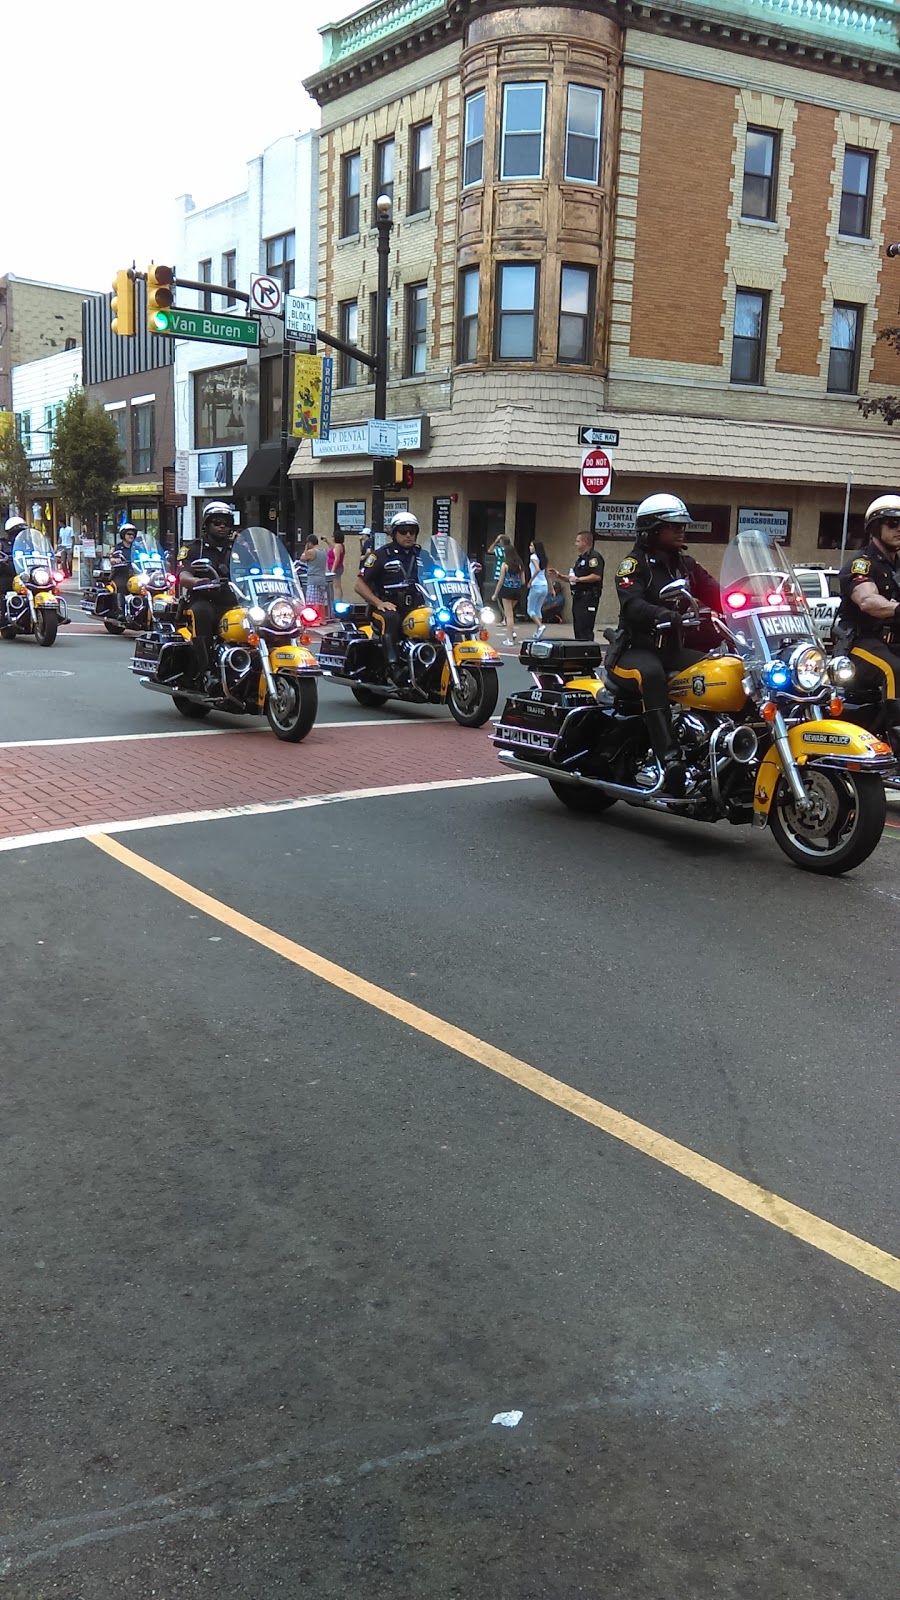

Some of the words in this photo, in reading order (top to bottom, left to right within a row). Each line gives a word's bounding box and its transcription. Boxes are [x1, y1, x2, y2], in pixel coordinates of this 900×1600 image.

[291, 309, 311, 321] BLOCK
[172, 315, 196, 332] Van
[203, 319, 241, 338] Buren
[247, 325, 255, 334] St
[288, 319, 299, 330] THE
[302, 322, 315, 333] BOX
[322, 358, 332, 439] IRONBOUND
[339, 429, 366, 443] DENTAL
[592, 432, 603, 441] ONE
[604, 433, 615, 441] WAY
[585, 458, 594, 466] DO
[595, 458, 607, 466] NOT
[586, 478, 604, 486] ENTER
[395, 502, 407, 510] STATE
[597, 505, 624, 513] GARDEN
[607, 513, 633, 521] DENTAL
[739, 516, 787, 526] LONGSHOREMEN
[26, 558, 49, 566] NEWARK
[254, 580, 289, 595] NEWARK
[440, 581, 470, 595] NEWARK
[761, 615, 809, 636] NEWARK
[531, 691, 543, 701] 832
[526, 705, 546, 716] TRAFFIC
[502, 727, 550, 748] POLICE
[804, 733, 827, 743] NEWARK
[828, 735, 850, 745] POLICE
